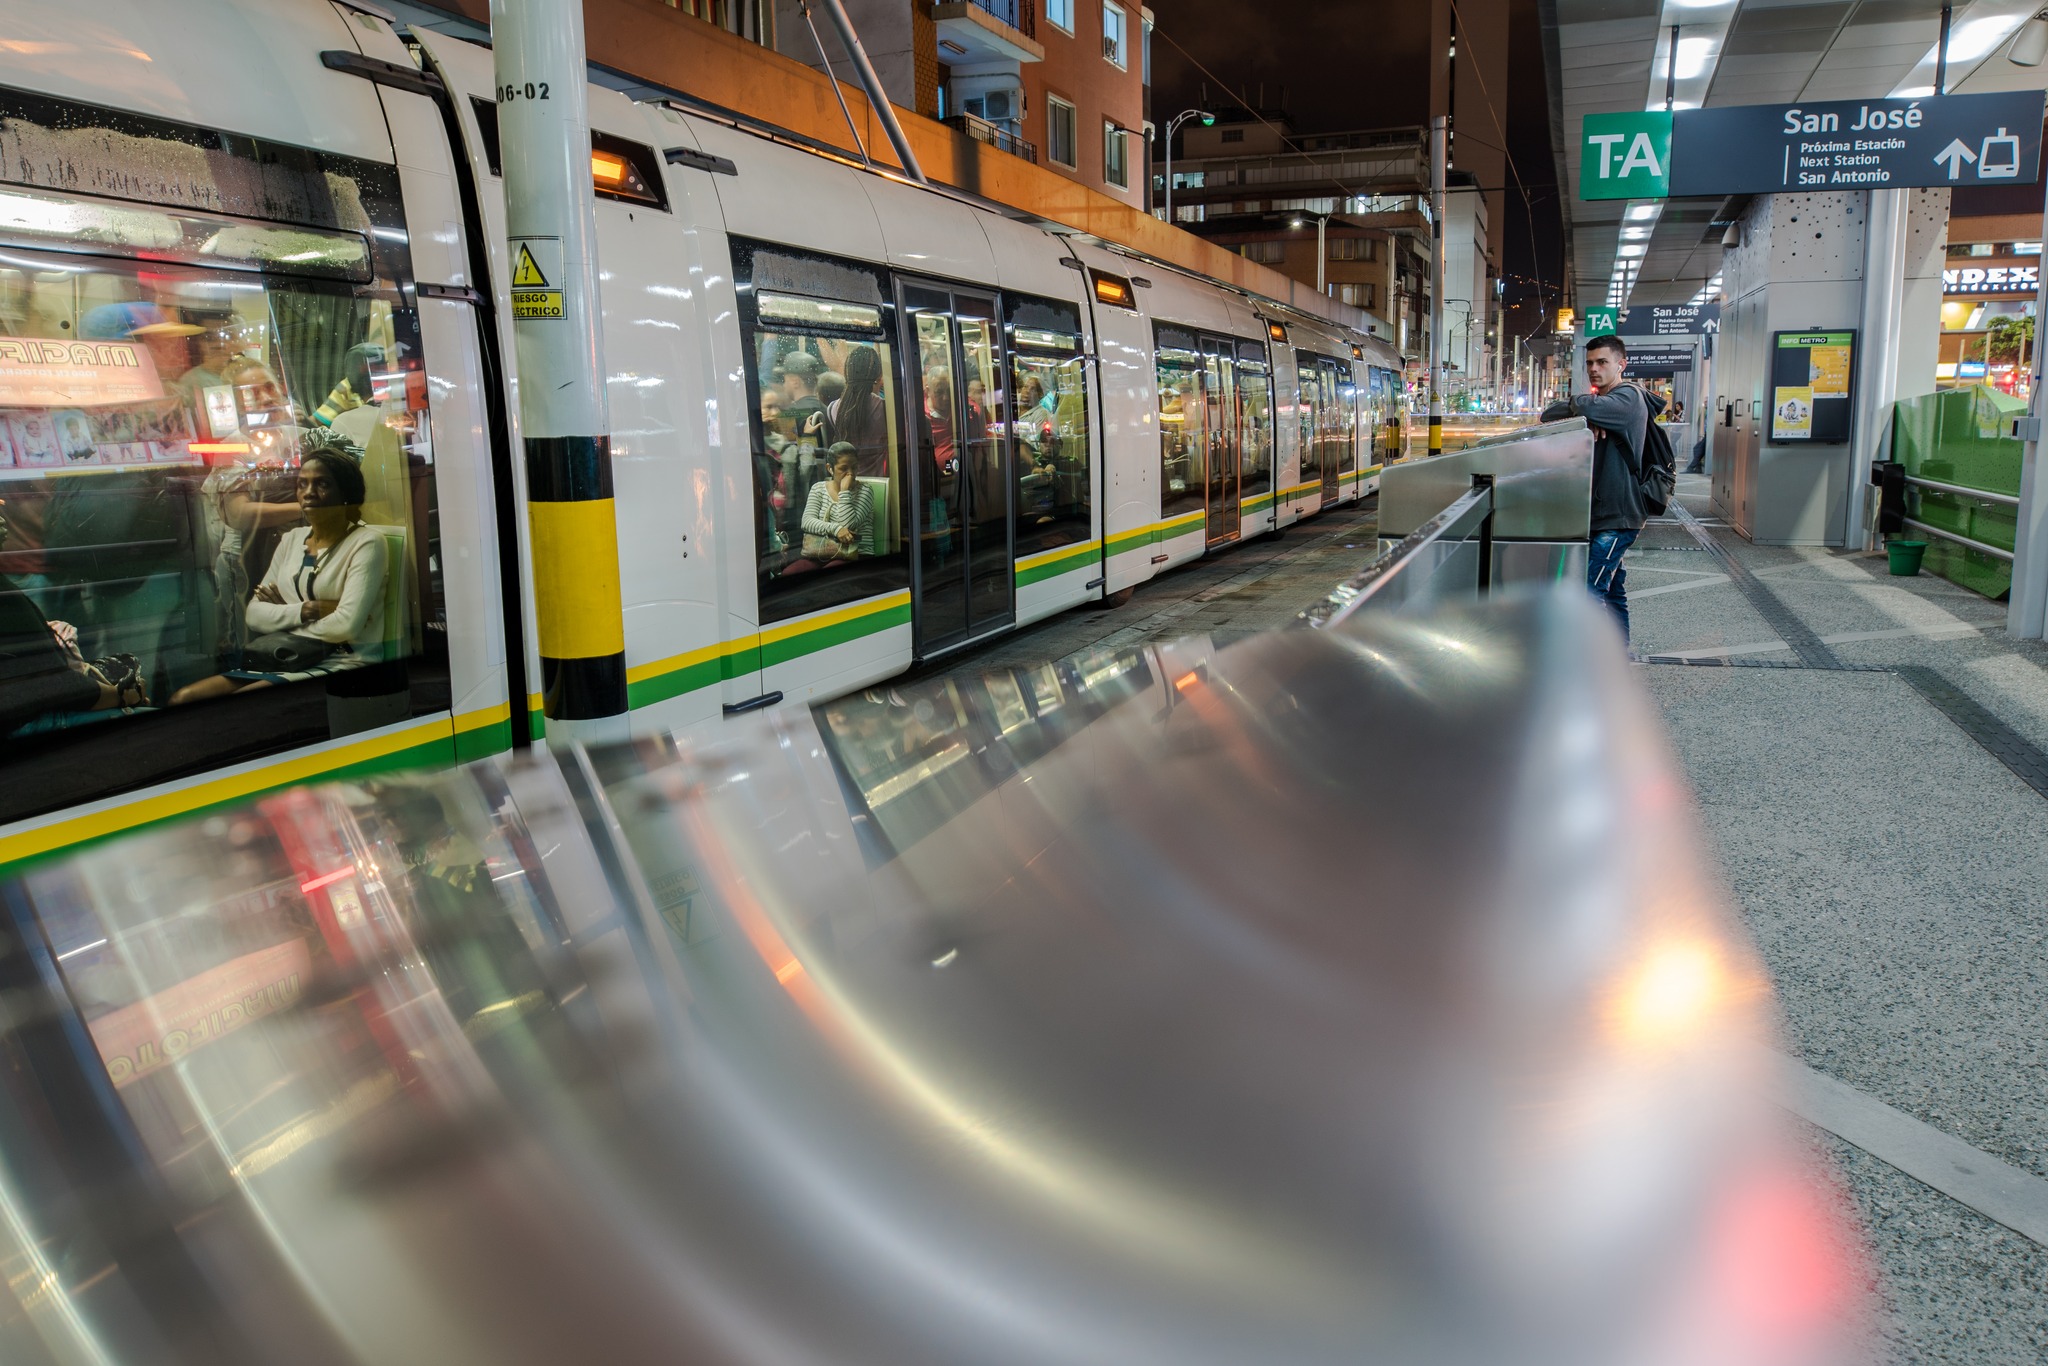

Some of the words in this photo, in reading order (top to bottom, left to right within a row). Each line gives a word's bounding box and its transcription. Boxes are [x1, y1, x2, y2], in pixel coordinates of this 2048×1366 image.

[496, 82, 550, 103] 06-02
[1783, 109, 1839, 134] San
[1850, 102, 1923, 131] José
[1800, 141, 1850, 153] Próxima
[1855, 138, 1906, 150] Estación
[1589, 132, 1662, 178] T-A
[1800, 156, 1830, 167] Next
[1834, 154, 1880, 166] Station
[1798, 172, 1826, 185] San
[1831, 169, 1890, 183] Antonio
[514, 294, 548, 303] RIESGO
[1653, 307, 1672, 317] San
[1675, 306, 1699, 316] José
[1587, 314, 1614, 330] T-A
